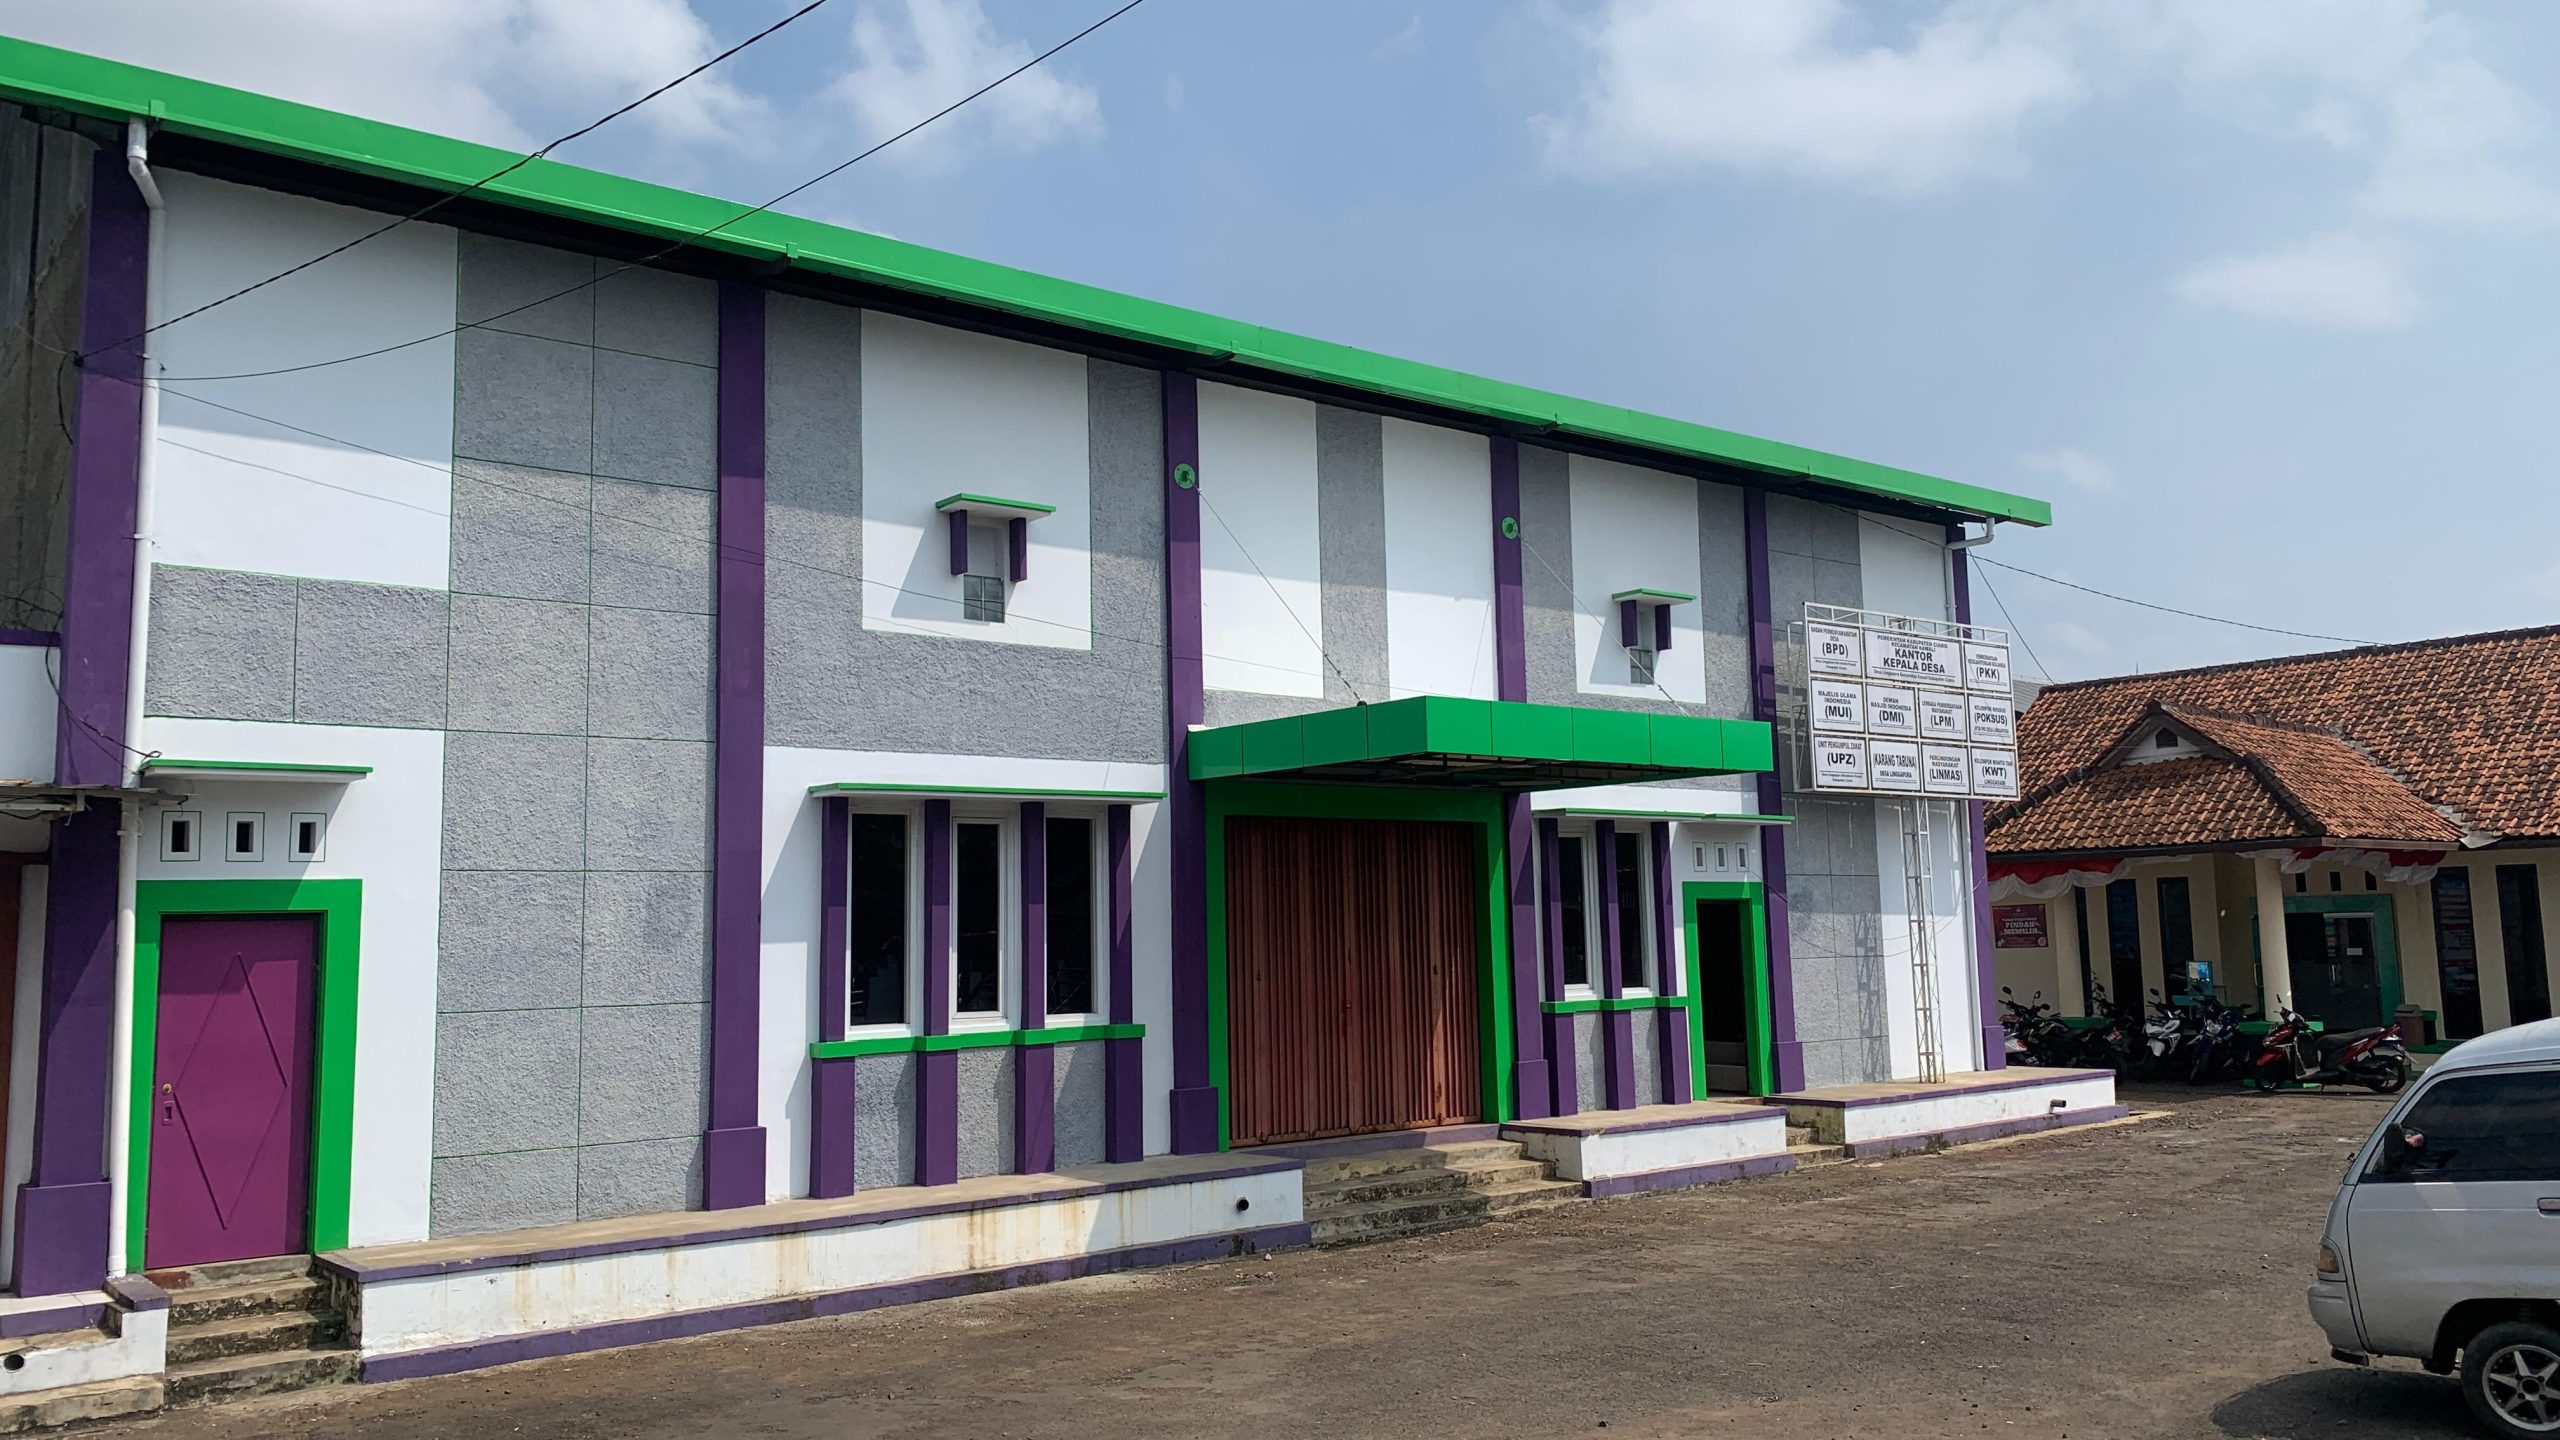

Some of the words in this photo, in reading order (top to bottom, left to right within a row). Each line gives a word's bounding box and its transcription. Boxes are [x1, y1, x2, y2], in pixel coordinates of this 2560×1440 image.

[1822, 642, 1849, 658] (BPD)
[1894, 647, 1933, 662] KANTOR
[1883, 657, 1919, 671] KEPALA
[1921, 662, 1945, 674] DESA
[1976, 666, 2000, 682] (PKK)
[1818, 690, 1839, 698] MAJELIS
[1824, 697, 1851, 705] INDONESIA
[1825, 705, 1852, 721] (MUI)
[1879, 710, 1905, 726] (DMI)
[1974, 712, 2008, 727] (POKSUS)
[1930, 714, 1955, 730] (LPM)
[1827, 752, 1856, 768] (UPZ)
[1929, 768, 1963, 784] (LINMAS)
[1982, 766, 2007, 780] (KWT)
